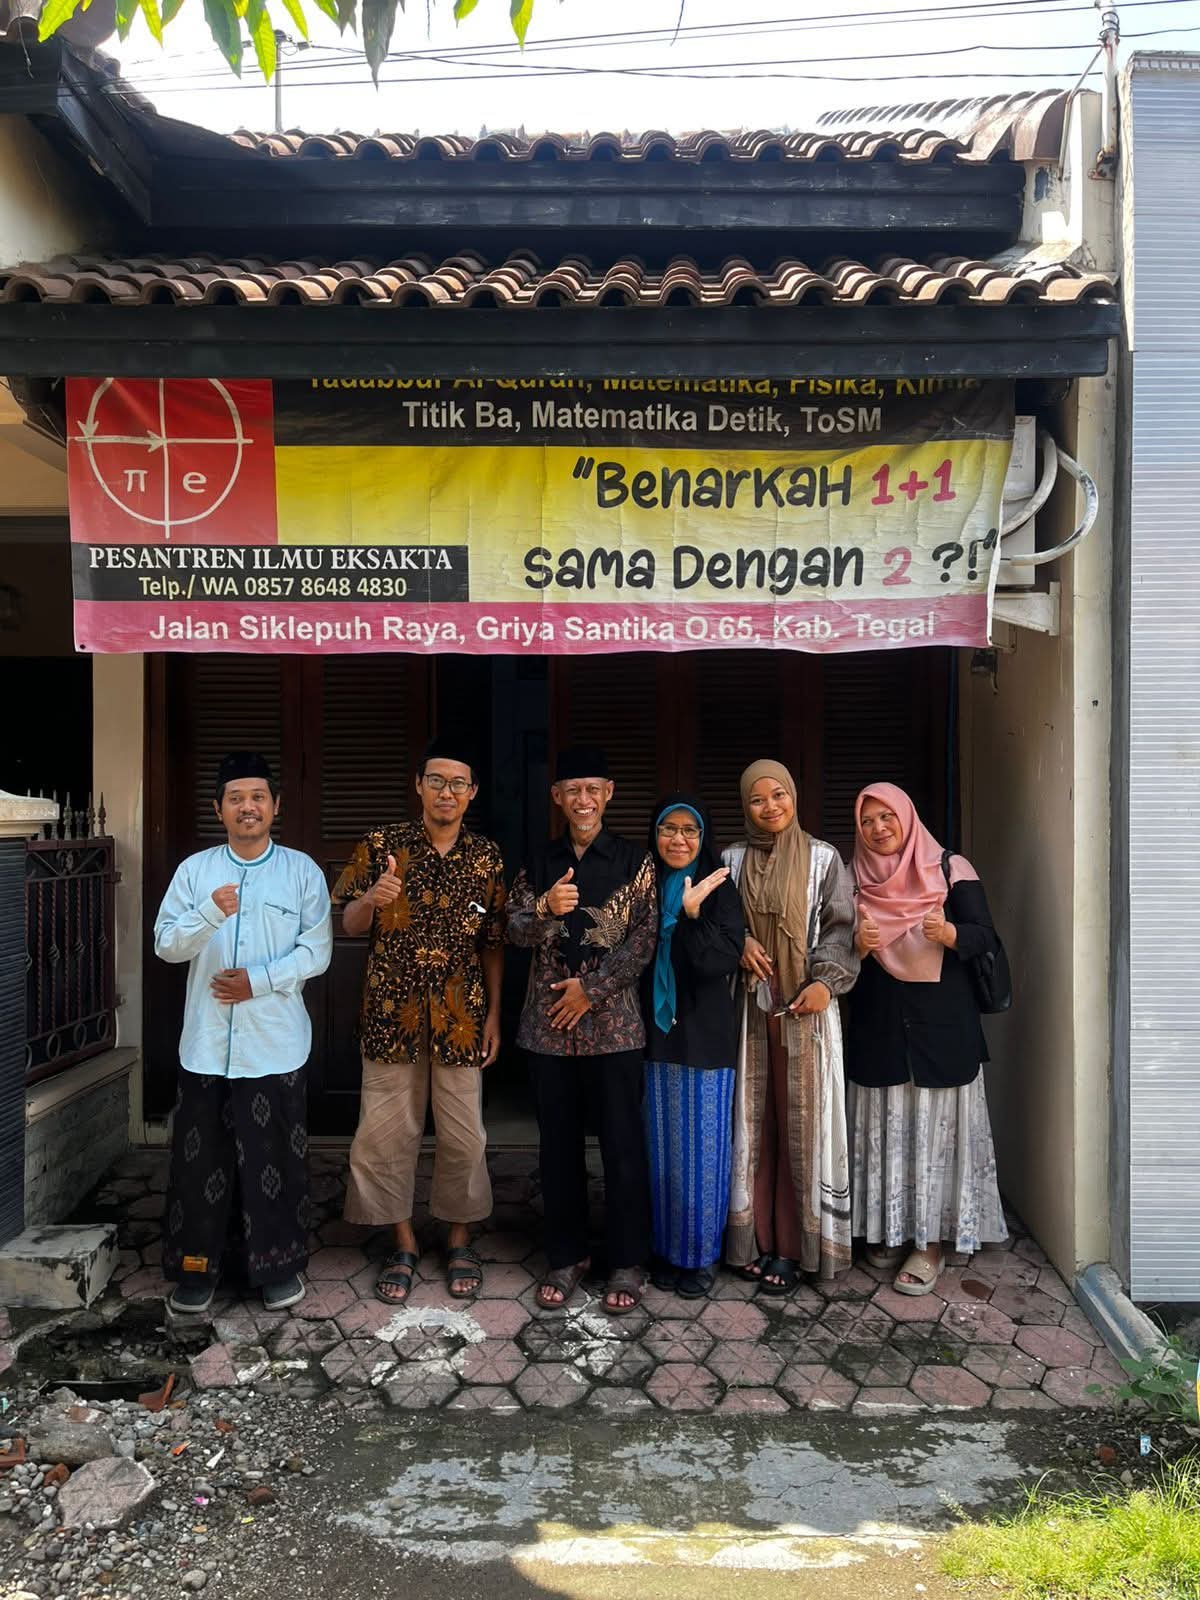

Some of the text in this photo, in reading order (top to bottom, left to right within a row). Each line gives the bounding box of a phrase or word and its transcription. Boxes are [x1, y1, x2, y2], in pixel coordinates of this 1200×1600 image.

[402, 400, 882, 436] Titik Ba, Matematika Detik, ToSM
[182, 472, 207, 493] e
[870, 458, 957, 506] 1+1
[89, 547, 453, 571] PESANTREN ILMU EKSAKTA
[673, 544, 864, 596] Dengan
[881, 546, 913, 586] 2
[139, 574, 408, 600] Telp./ WA 0857 8648 4830
[149, 615, 229, 641] Jalan
[239, 615, 373, 646] Siklepuh
[382, 616, 466, 646] Raya,
[475, 616, 556, 647] Griya
[564, 615, 676, 642] Santika
[773, 615, 841, 640] Kab.
[850, 611, 936, 641] Tegal
